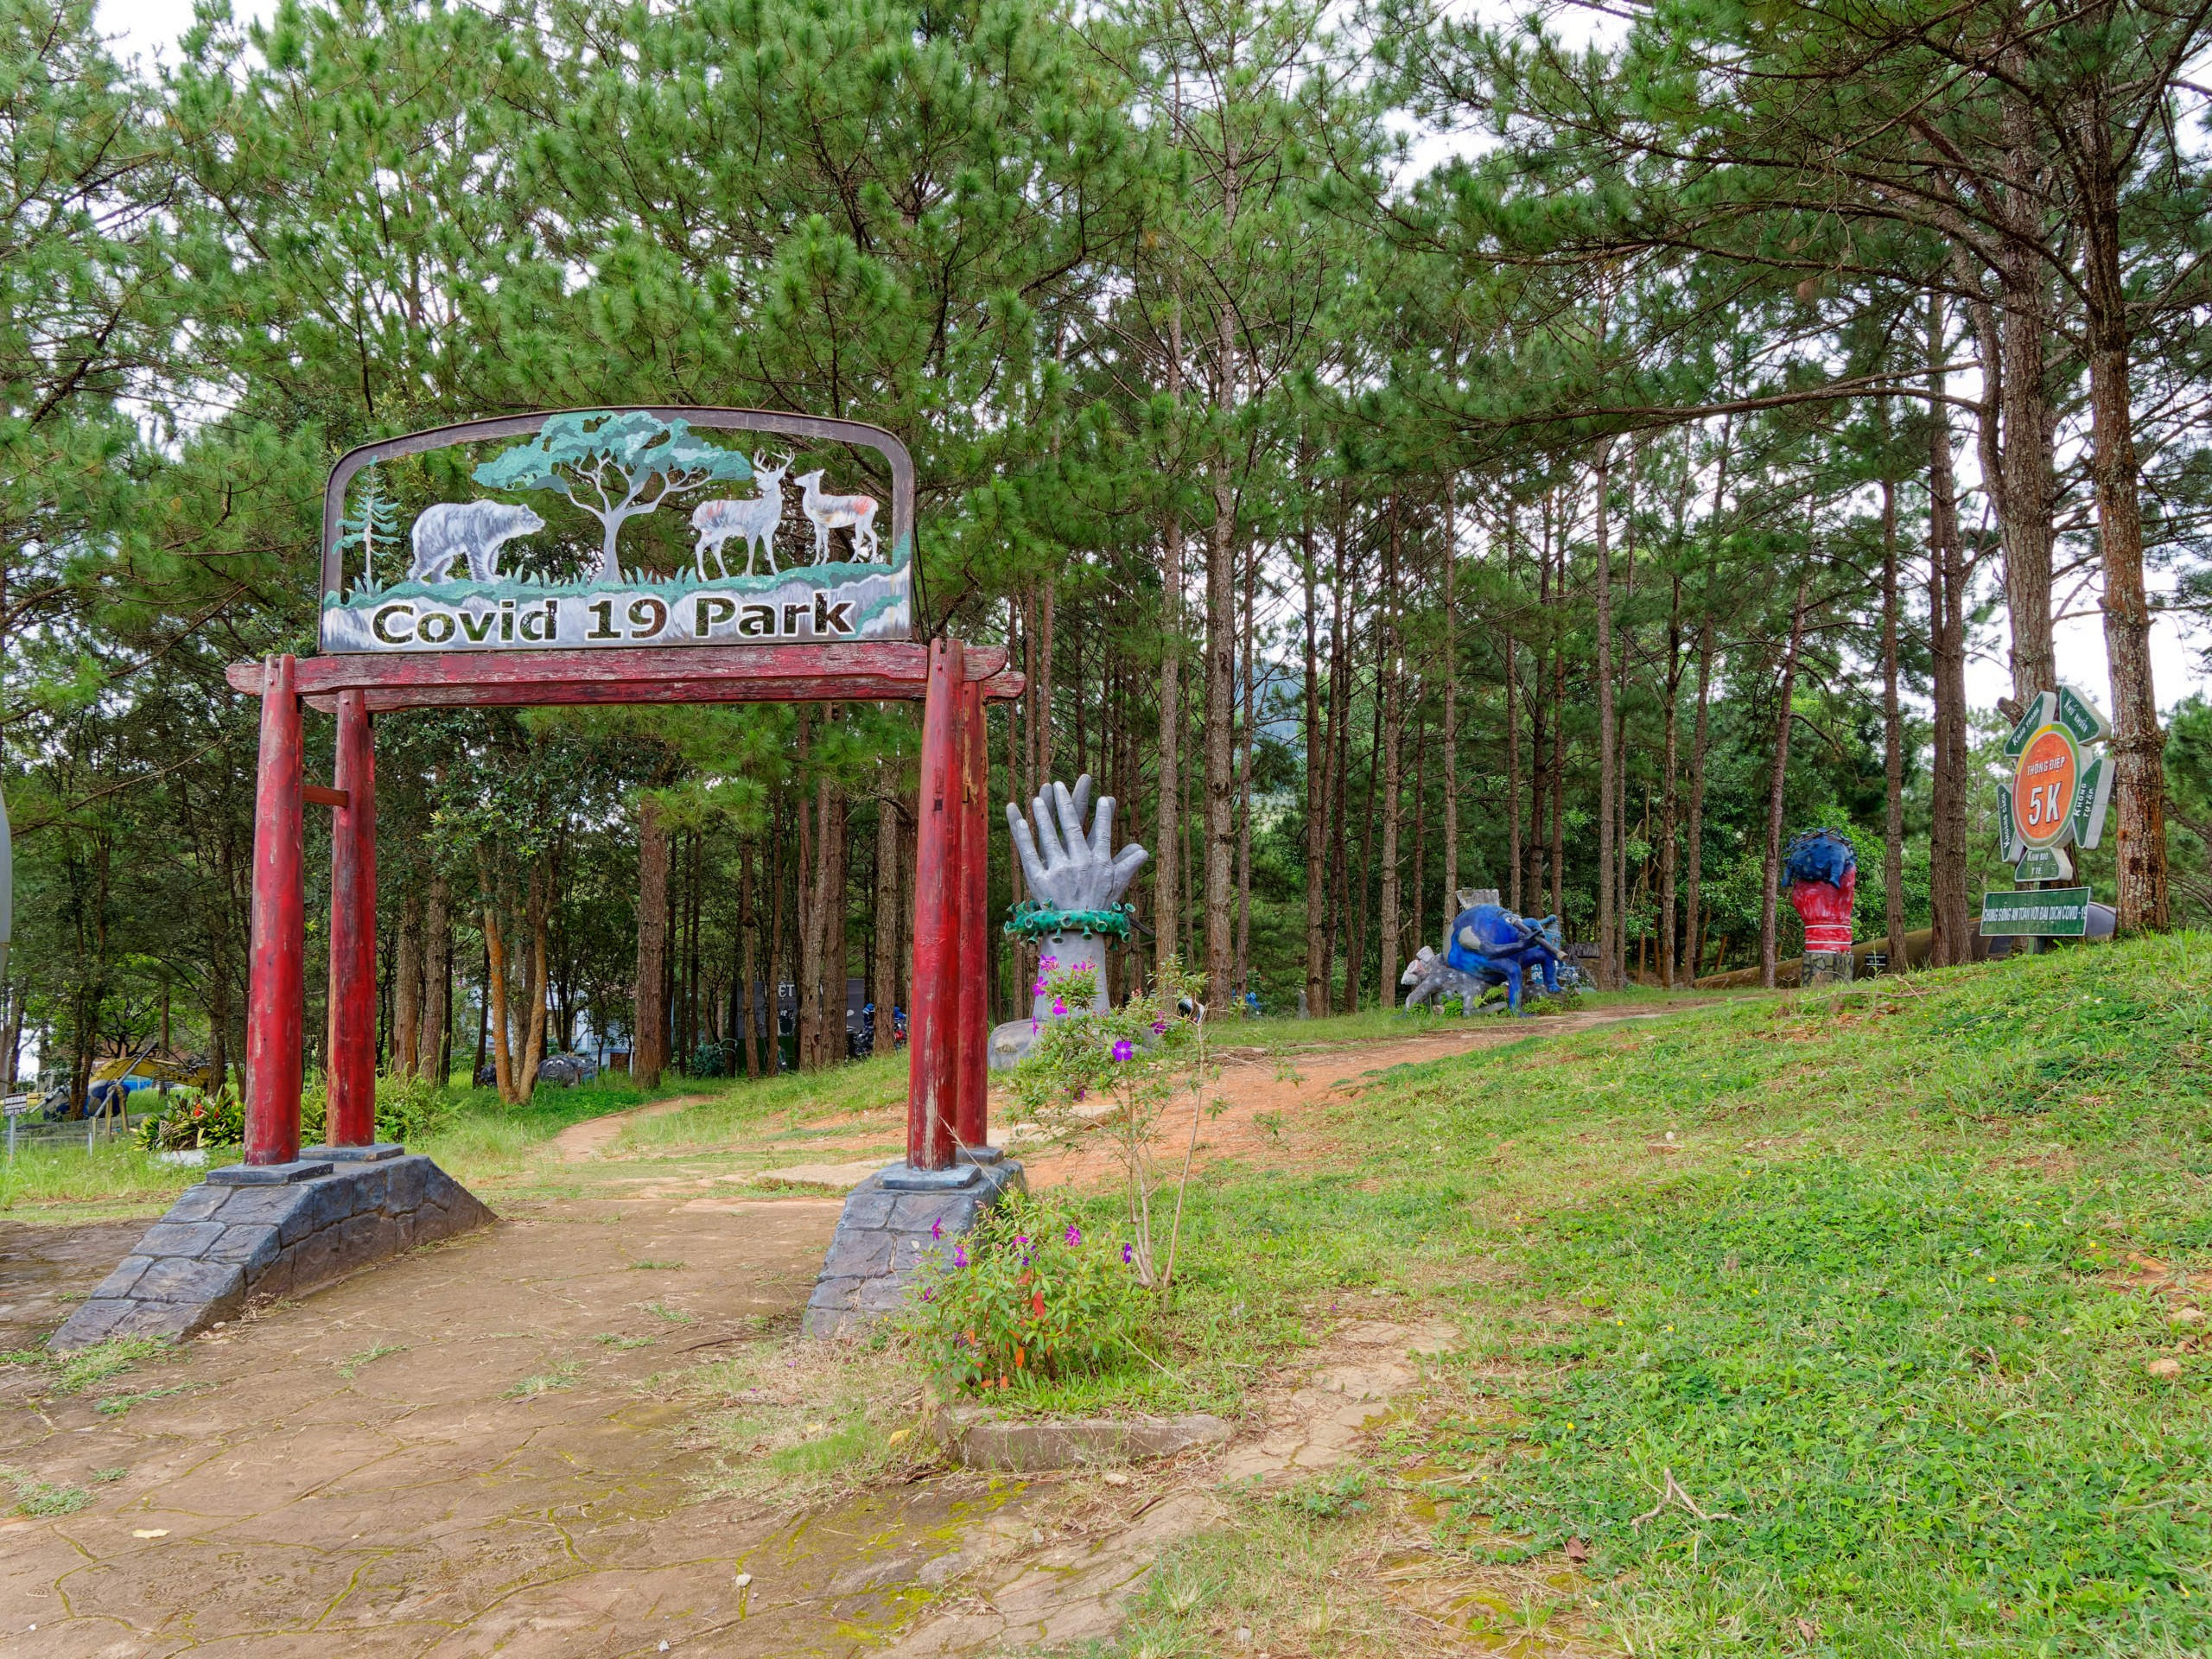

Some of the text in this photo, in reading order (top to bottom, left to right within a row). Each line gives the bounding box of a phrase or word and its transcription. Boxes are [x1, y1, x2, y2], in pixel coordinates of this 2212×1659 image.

[371, 588, 857, 645] Covid 19 Park
